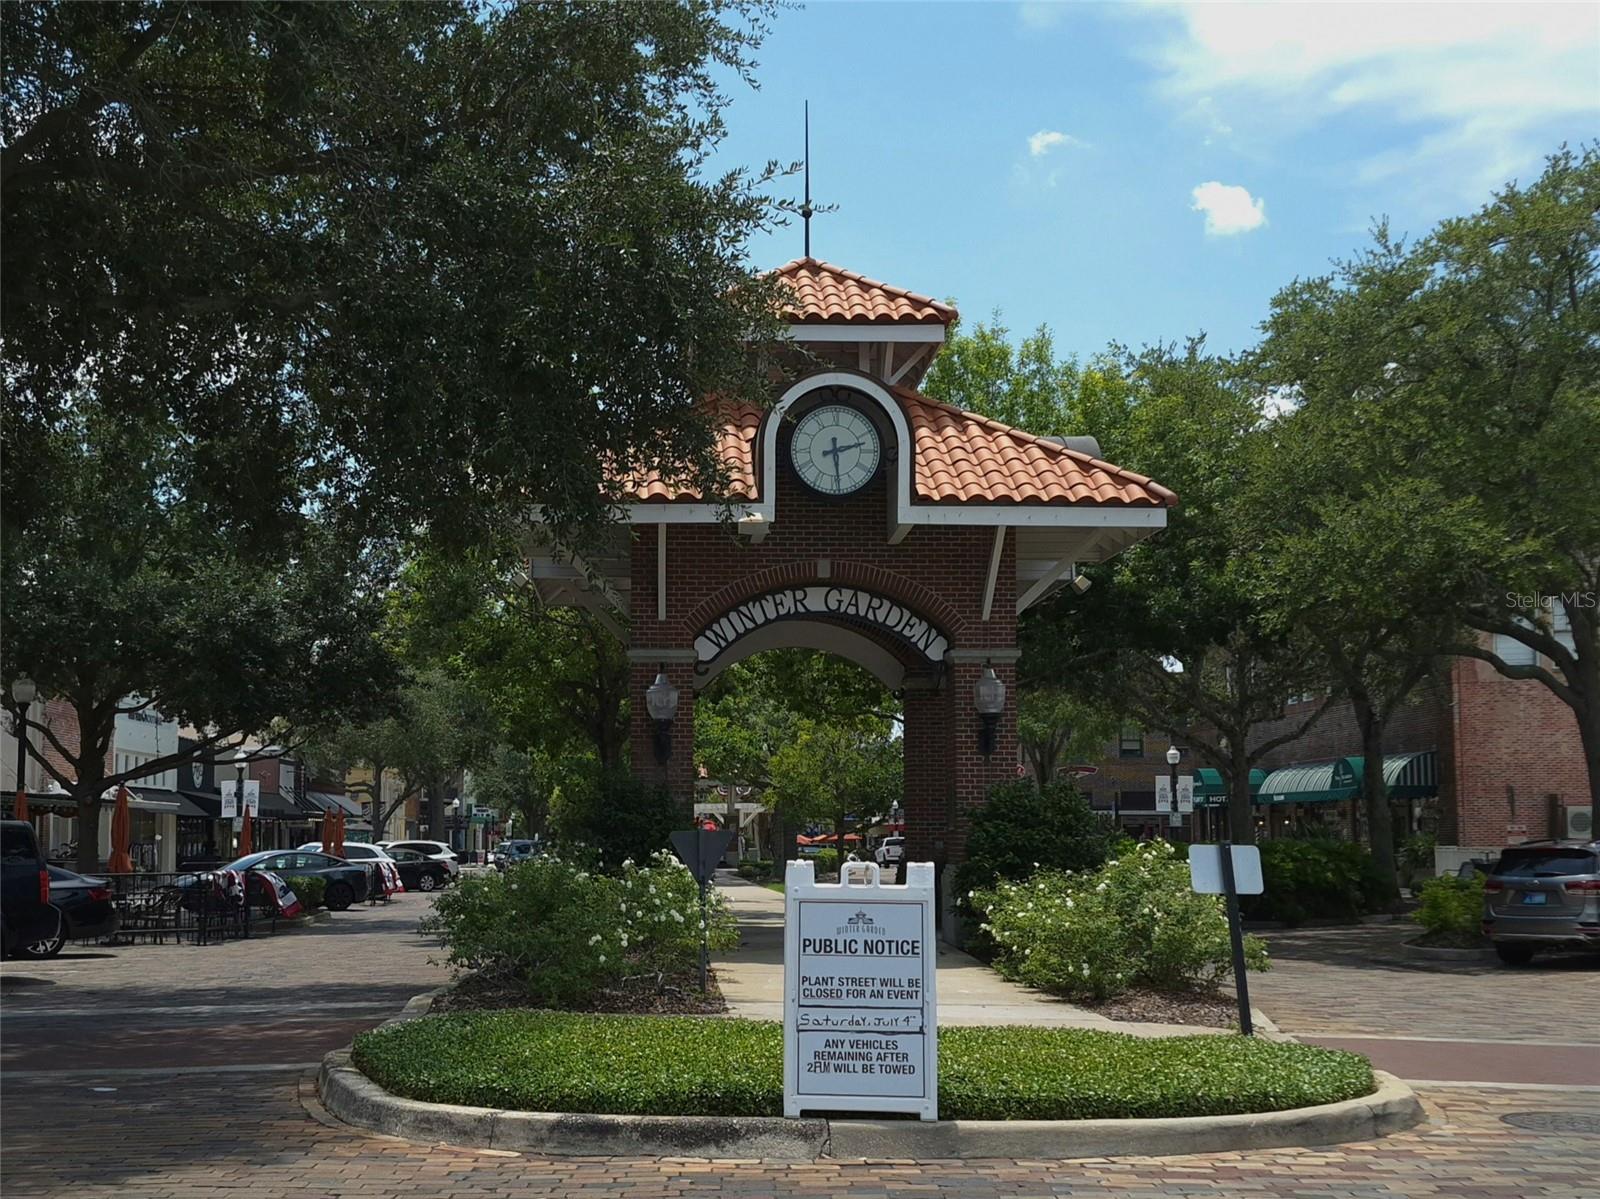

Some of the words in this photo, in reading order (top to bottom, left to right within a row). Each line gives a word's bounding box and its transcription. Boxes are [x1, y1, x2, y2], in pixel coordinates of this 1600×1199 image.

[704, 589, 807, 650] WINTER
[824, 588, 943, 655] GARDEN
[802, 938, 858, 955] PUBLIC
[863, 939, 921, 956] NOTICE
[801, 976, 835, 986] PLANT
[838, 977, 877, 987] STREET
[879, 978, 904, 988] WILL
[907, 978, 921, 989] BE
[802, 988, 843, 999] CLOSED
[846, 988, 866, 999] FOR
[869, 989, 884, 999] AN
[887, 989, 920, 1000] EVENT
[824, 1039, 845, 1049] ANY
[848, 1039, 898, 1050] VEHICLES
[813, 1051, 873, 1062] REMAINING
[876, 1052, 909, 1063] AFTER
[833, 1063, 858, 1073] WILL
[861, 1063, 876, 1074] BE
[878, 1063, 916, 1075] TOWED
